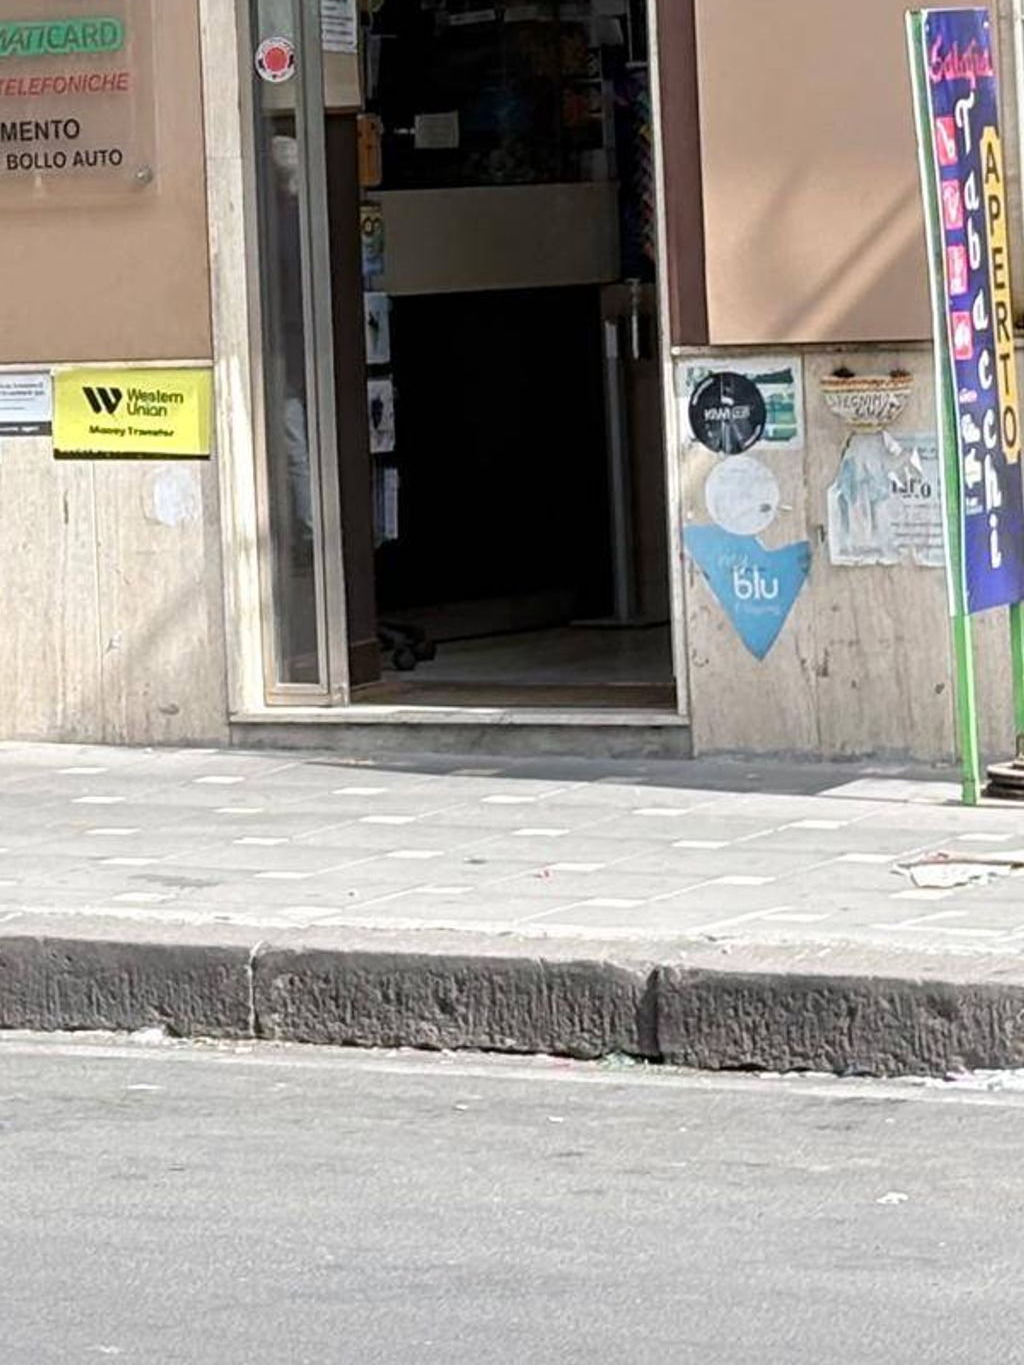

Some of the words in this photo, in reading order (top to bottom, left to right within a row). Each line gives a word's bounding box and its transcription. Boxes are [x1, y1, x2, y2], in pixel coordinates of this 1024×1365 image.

[6, 151, 67, 171] BOLLO
[72, 148, 123, 168] AUTO
[984, 141, 1017, 450] APERTO
[127, 388, 184, 404] Western
[127, 403, 168, 417] Union
[734, 565, 779, 600] blu
